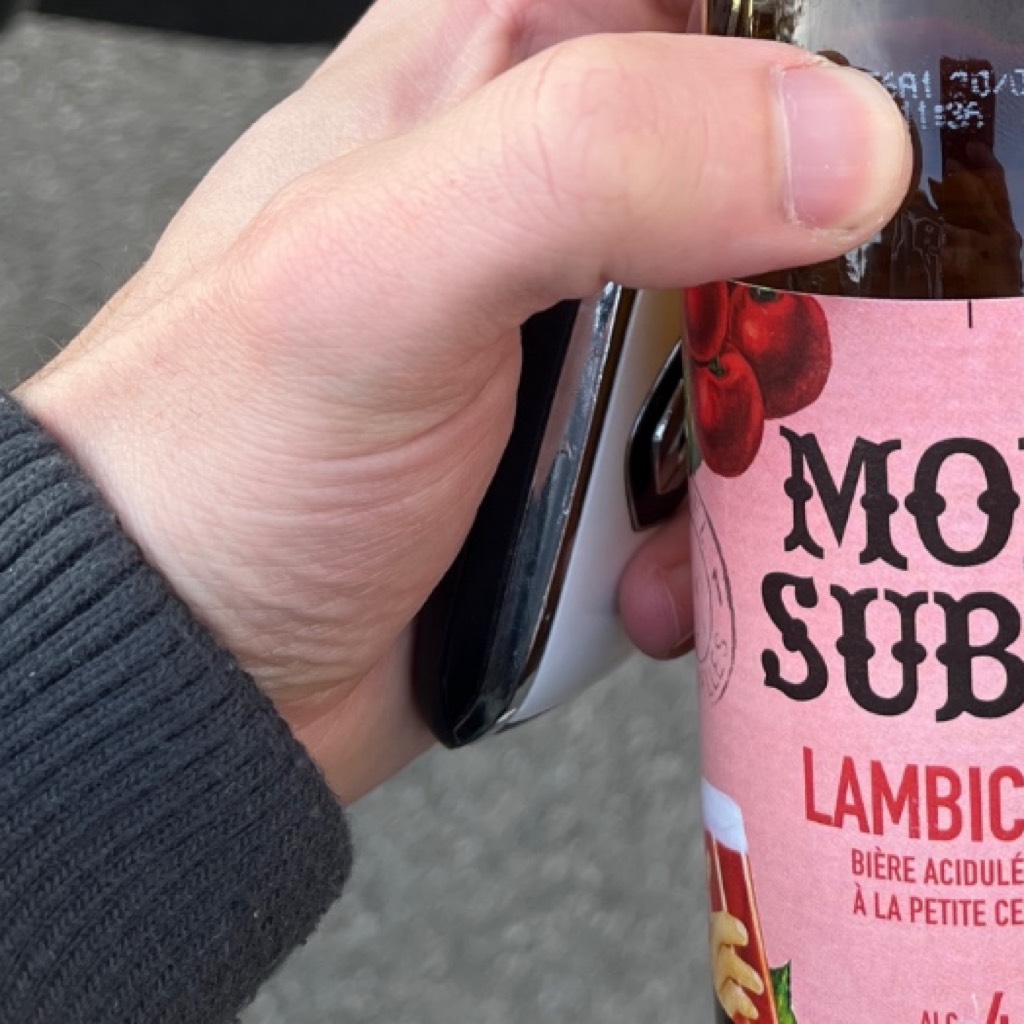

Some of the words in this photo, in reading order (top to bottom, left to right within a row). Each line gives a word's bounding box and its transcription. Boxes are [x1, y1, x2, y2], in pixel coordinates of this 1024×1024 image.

[851, 845, 916, 883] BIÈRE
[853, 882, 867, 916] À
[874, 891, 901, 921] LA
[910, 896, 986, 926] PETITE
